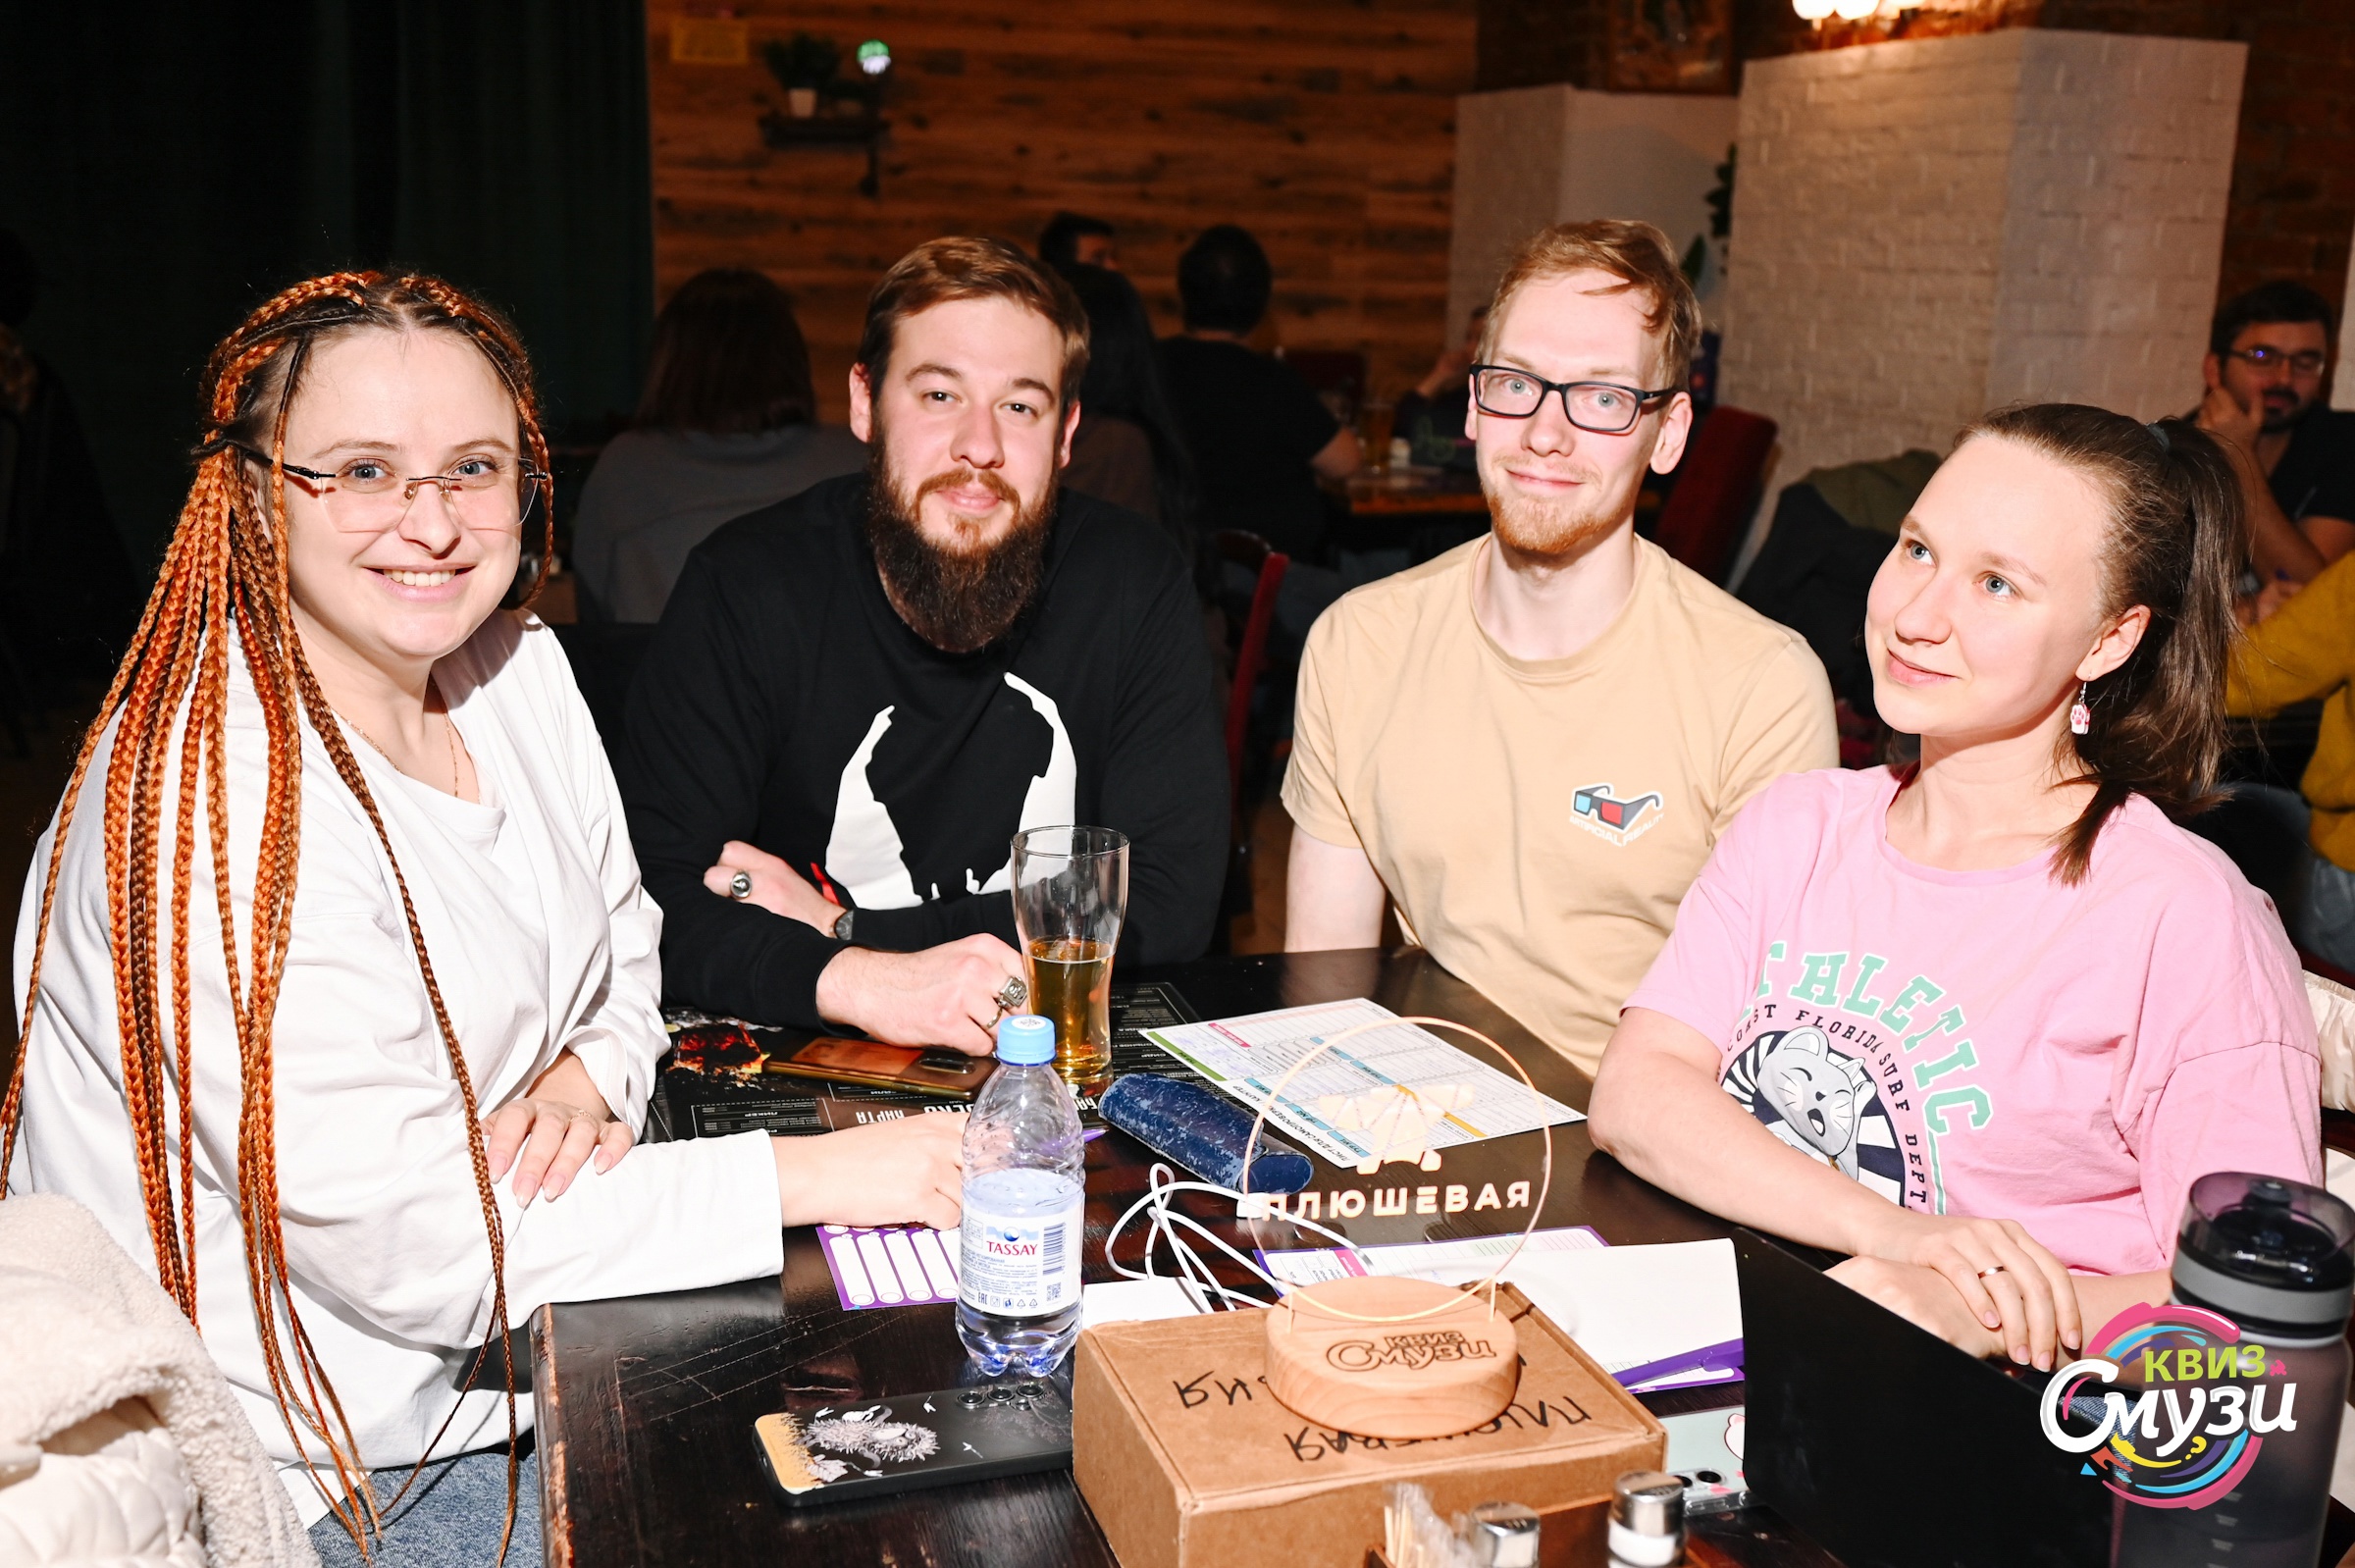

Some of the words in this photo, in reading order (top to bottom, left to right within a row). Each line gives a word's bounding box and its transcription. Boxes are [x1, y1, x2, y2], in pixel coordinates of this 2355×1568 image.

[1622, 811, 1665, 848] REALITY
[1735, 940, 1994, 1136] THLETIC
[1795, 1010, 1884, 1054] FLORIDA
[1878, 1053, 1910, 1112] SURF
[1265, 1105, 1316, 1139] САМОПРОВЕРК
[1262, 1180, 1531, 1222] ПЛЮШЕВАЯ
[986, 1240, 1038, 1256] TASSAY
[1327, 1339, 1497, 1373] Смузи
[1385, 1331, 1465, 1349] КВИЗ
